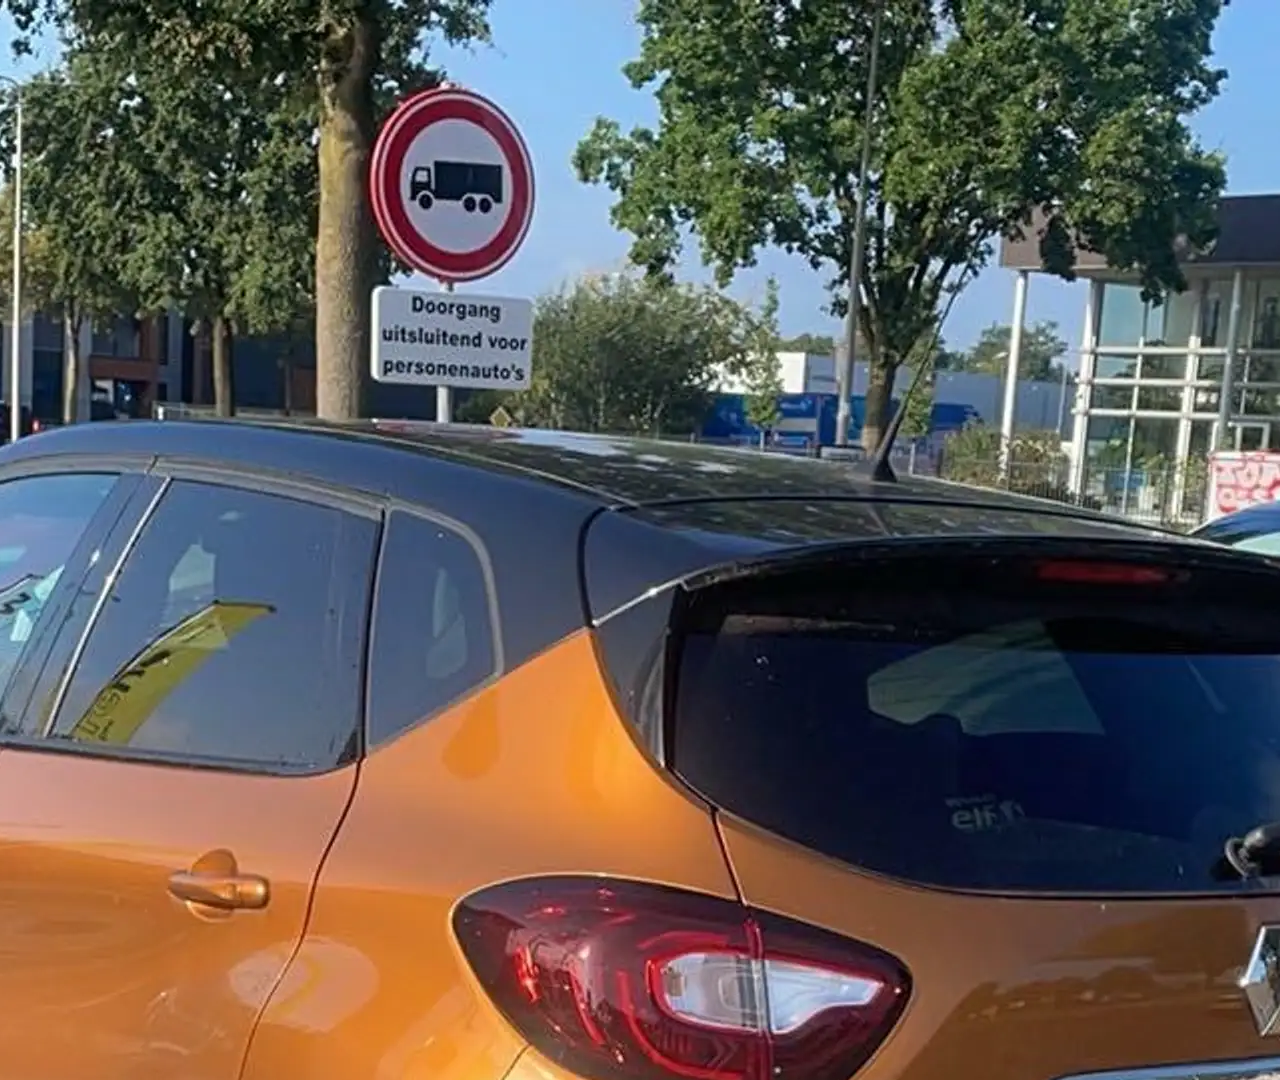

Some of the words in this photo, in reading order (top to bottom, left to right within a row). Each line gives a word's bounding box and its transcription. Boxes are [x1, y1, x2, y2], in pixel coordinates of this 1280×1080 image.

[412, 296, 501, 323] Doorgang
[382, 326, 483, 349] uitsluitend
[488, 335, 528, 351] voor
[383, 359, 524, 382] personenauto's
